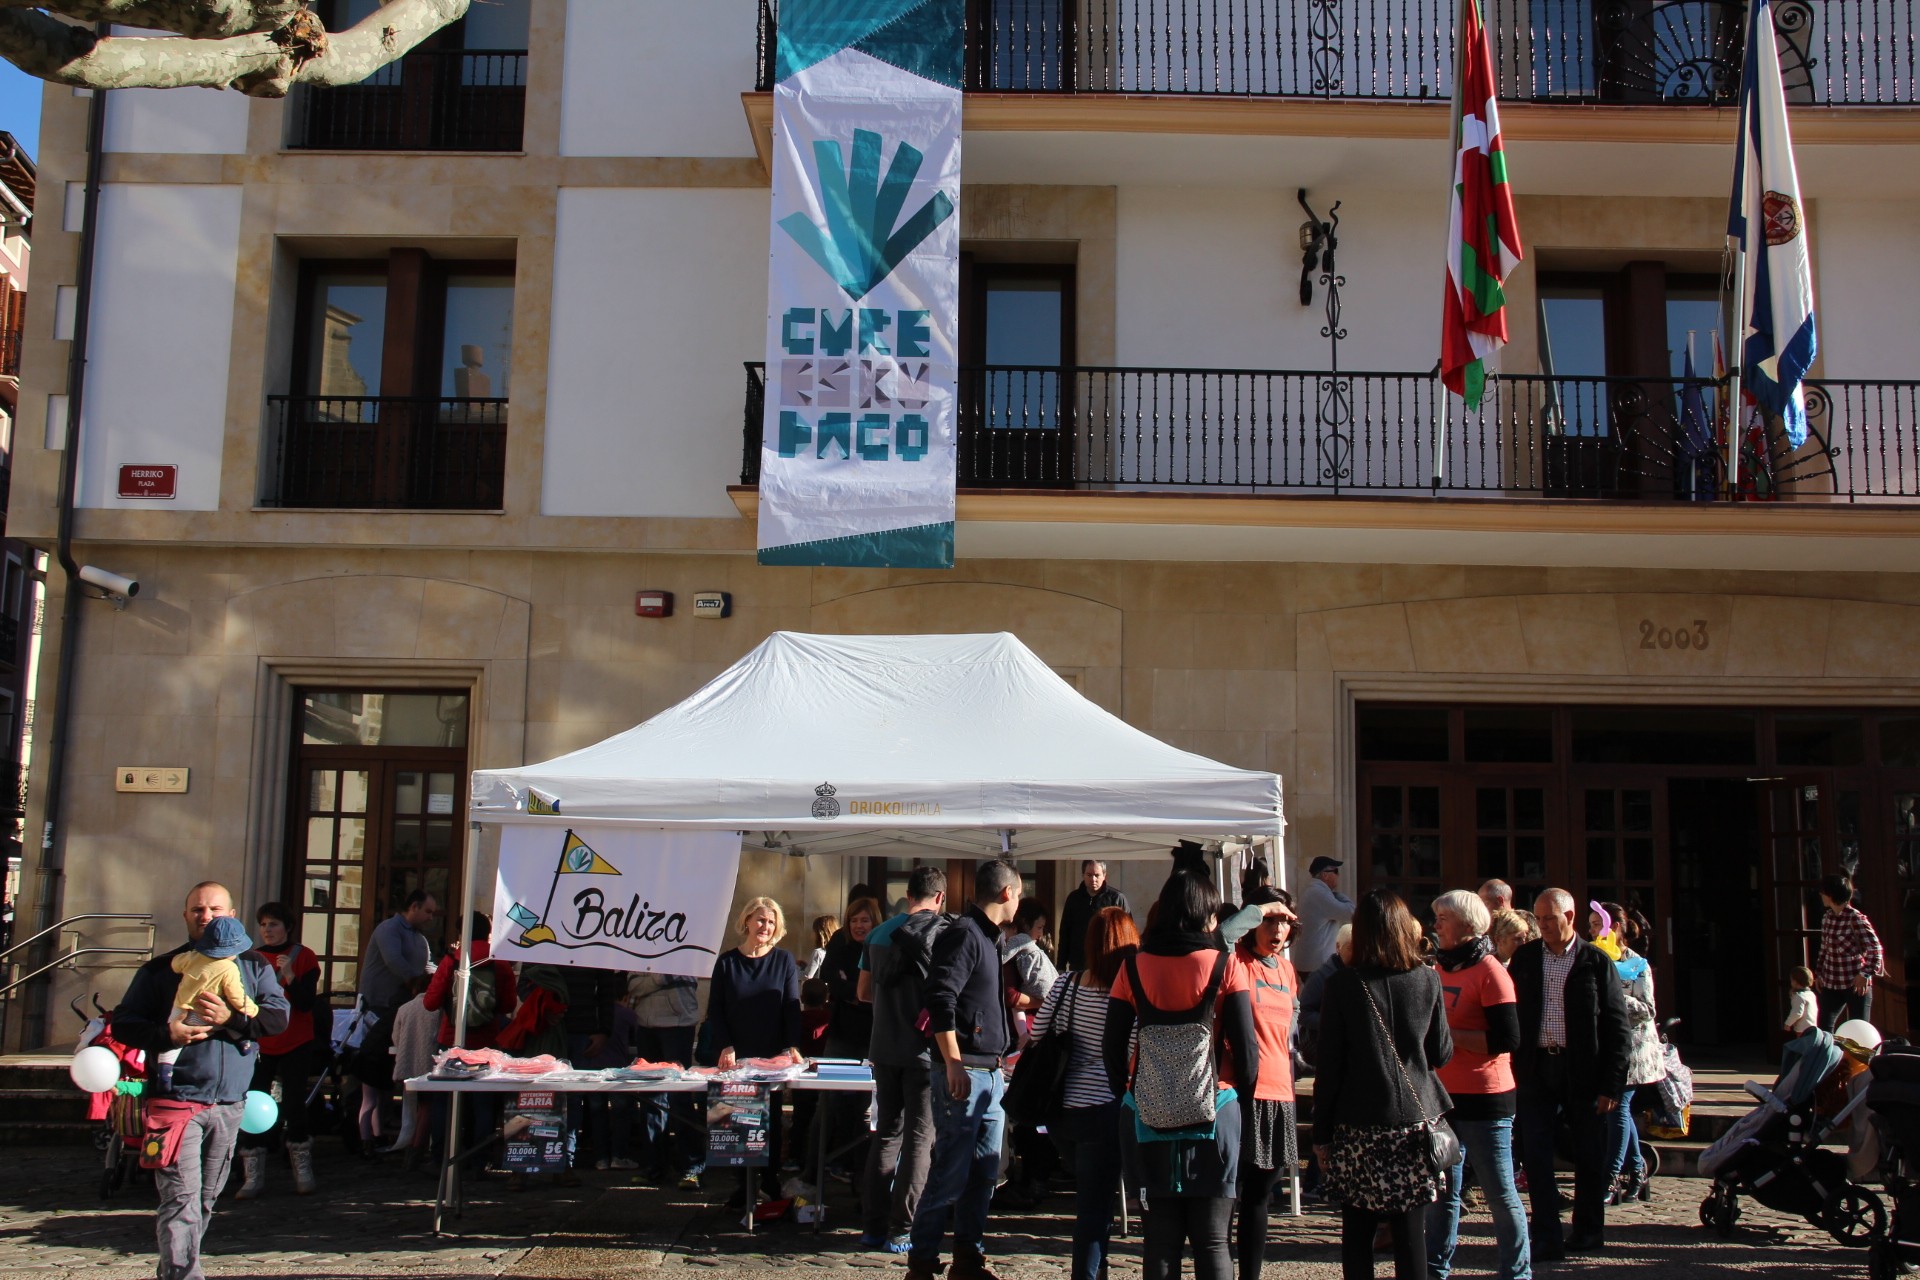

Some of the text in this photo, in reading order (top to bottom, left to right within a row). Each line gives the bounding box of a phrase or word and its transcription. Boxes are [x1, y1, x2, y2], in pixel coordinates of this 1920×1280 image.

[780, 358, 930, 410] ESKU
[131, 470, 164, 478] HERRIKO
[696, 600, 720, 608] Area7
[1638, 618, 1710, 651] 2003
[560, 887, 689, 945] Baliza
[722, 1084, 757, 1093] SARIA
[519, 1097, 553, 1106] SARIA
[709, 1134, 740, 1142] 30.000€
[747, 1129, 766, 1142] 5€
[507, 1147, 538, 1155] 30.000€
[545, 1141, 564, 1155] 5€
